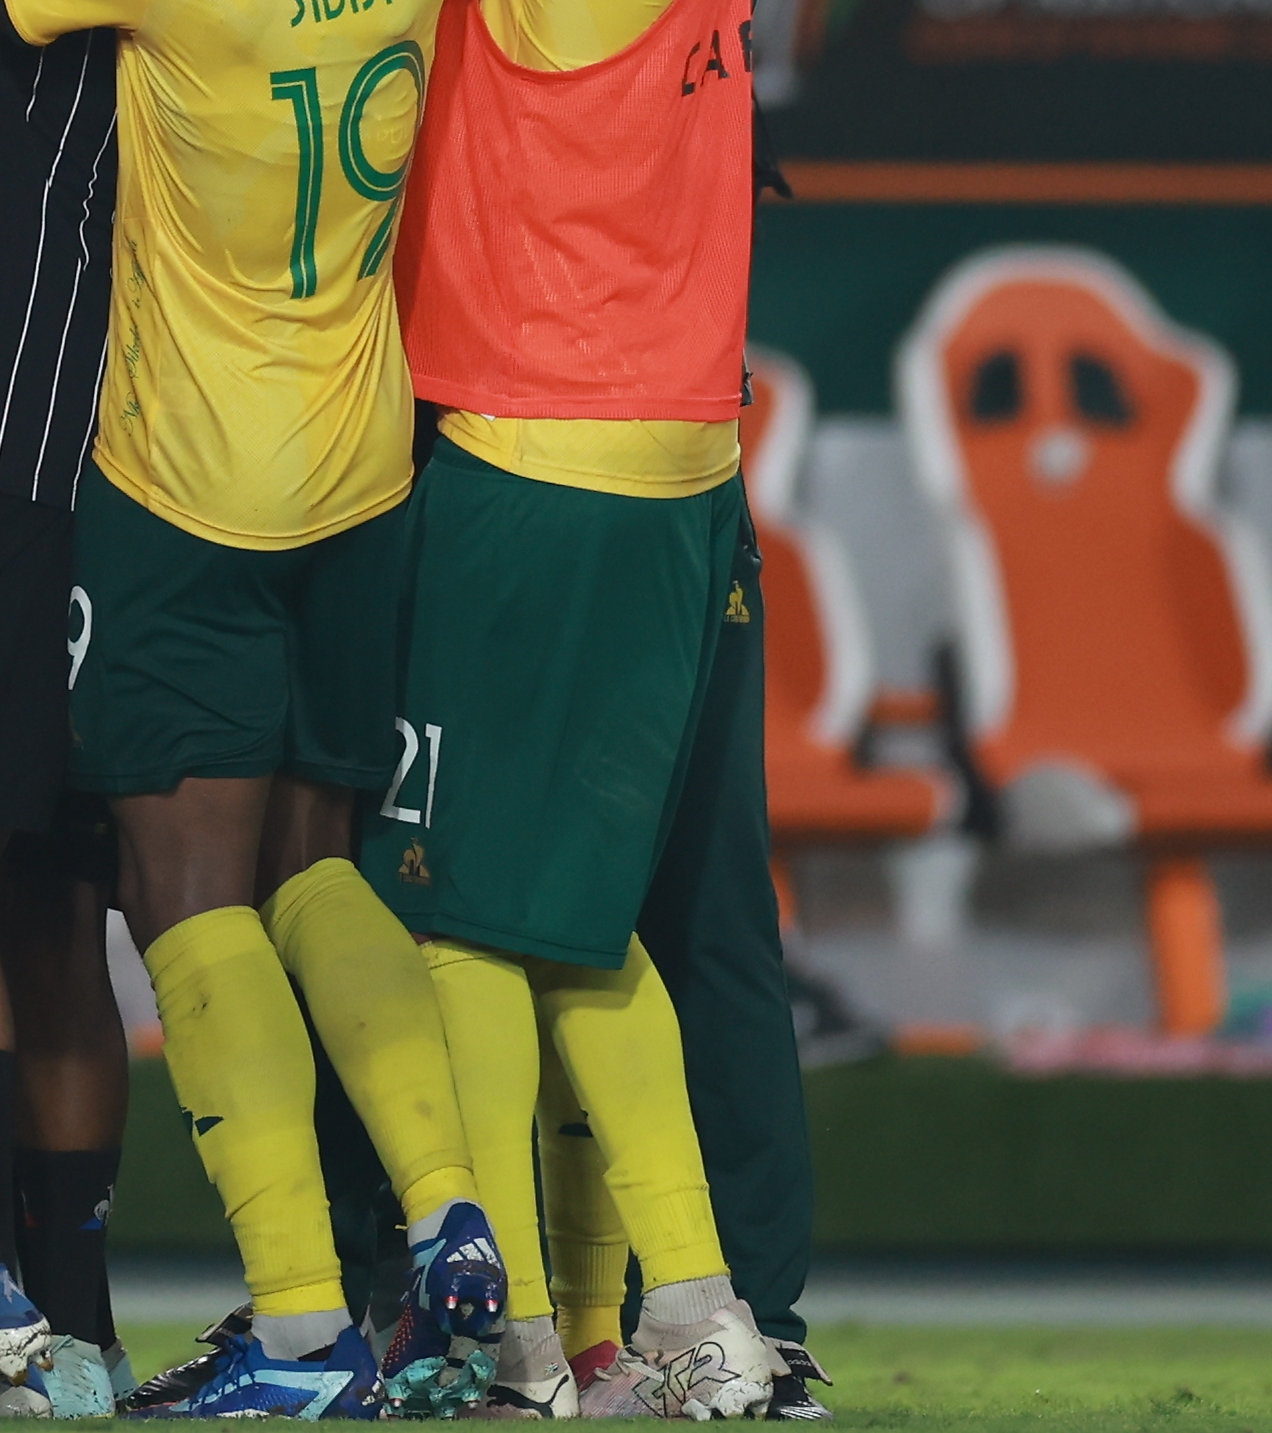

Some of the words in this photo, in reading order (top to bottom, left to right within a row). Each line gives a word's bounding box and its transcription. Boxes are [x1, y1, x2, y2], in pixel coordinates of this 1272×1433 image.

[270, 39, 426, 299] 19
[67, 585, 93, 691] 9
[379, 716, 443, 829] 21
